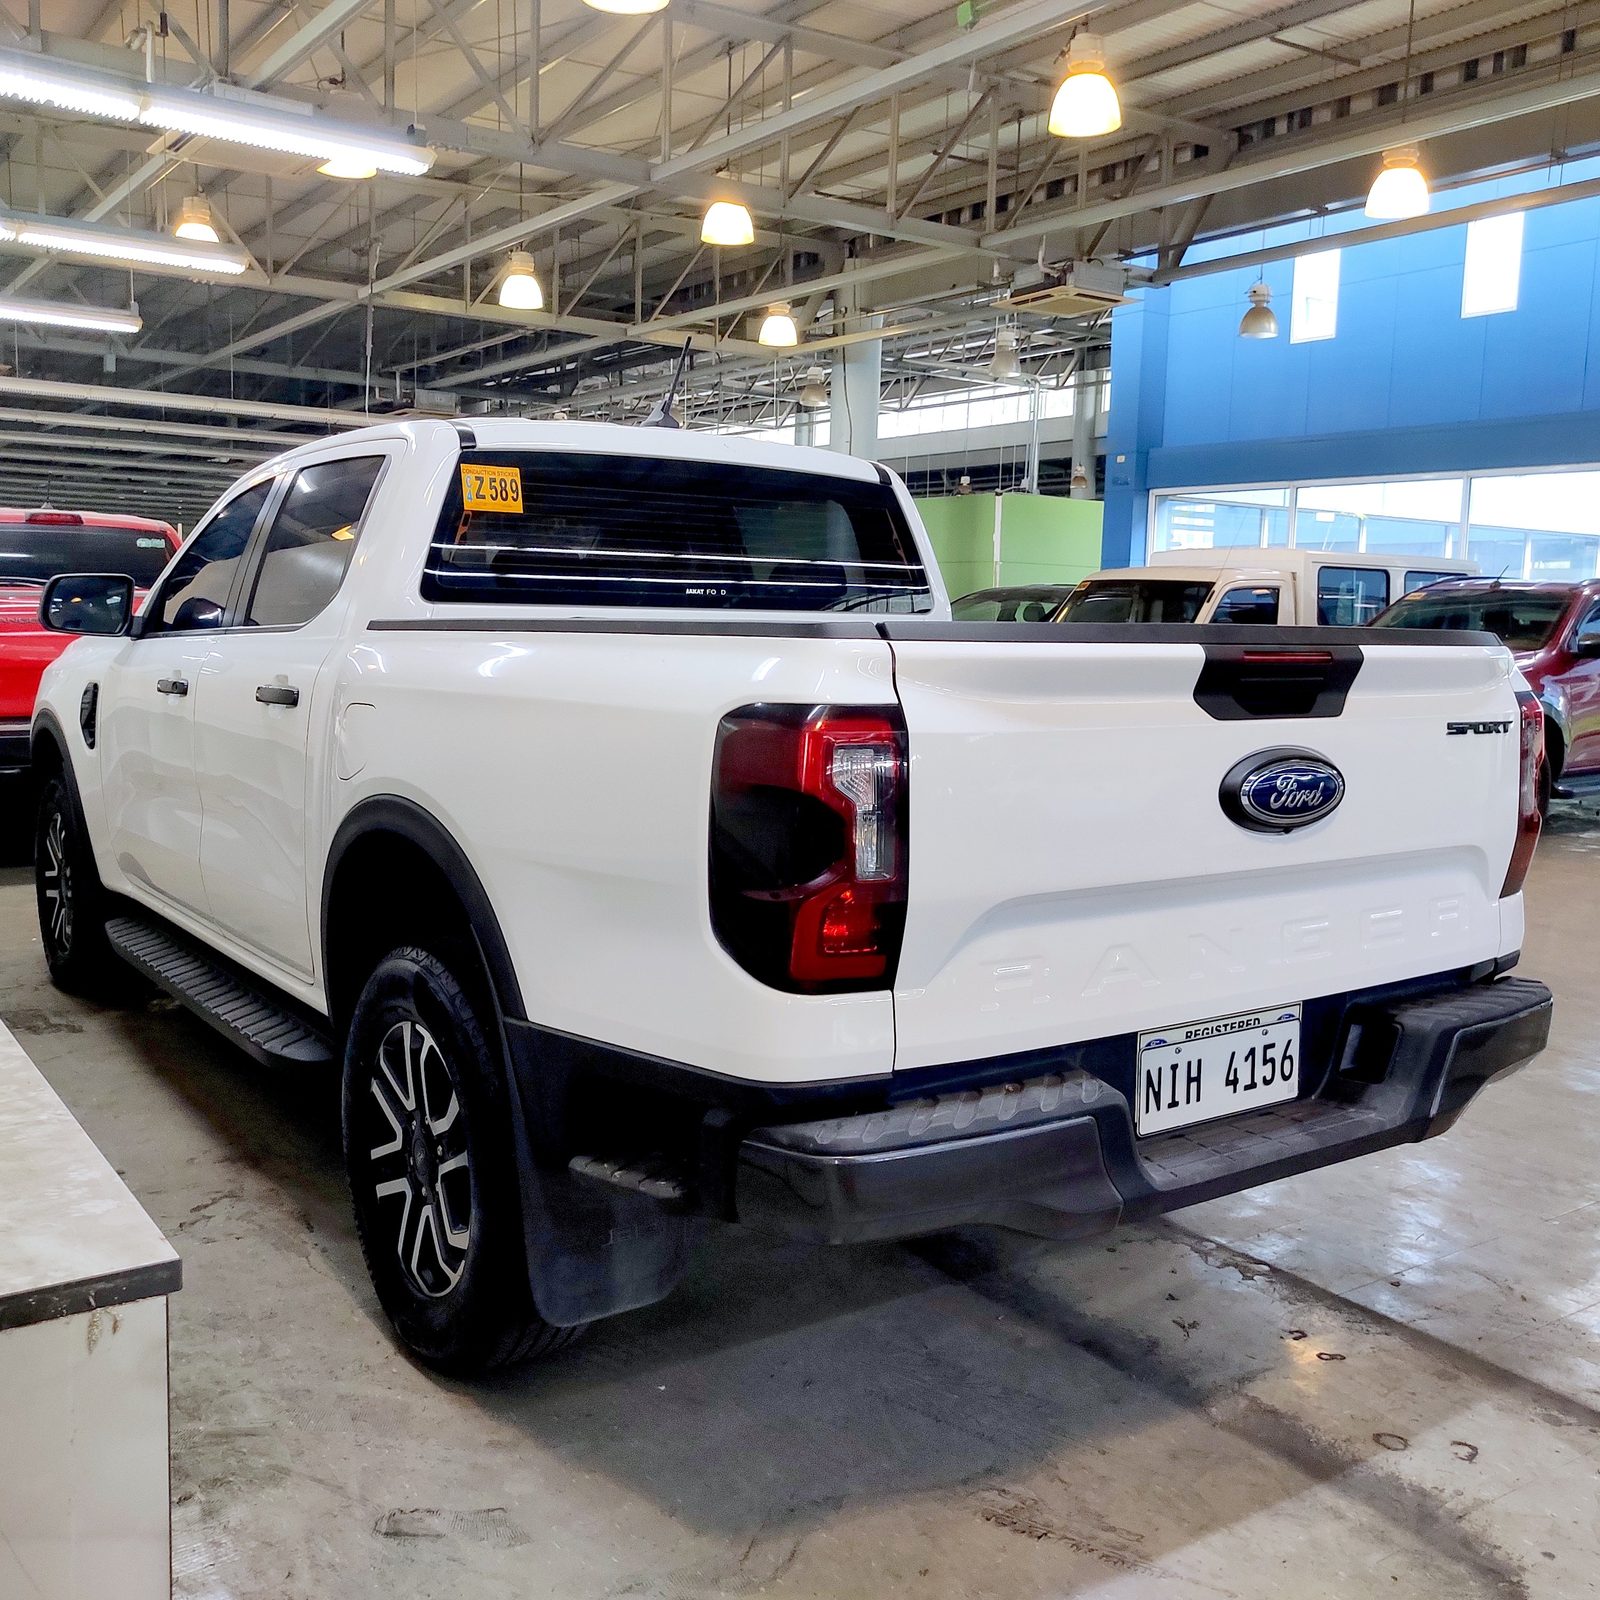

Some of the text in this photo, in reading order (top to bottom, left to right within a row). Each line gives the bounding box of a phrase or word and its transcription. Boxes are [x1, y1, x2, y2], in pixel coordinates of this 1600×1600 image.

[1446, 720, 1513, 735] SPORT
[1269, 774, 1324, 808] Ford
[979, 893, 1471, 1011] RANGER
[1185, 1017, 1261, 1039] REGISTERED
[1145, 1038, 1294, 1114] NIH 4156
